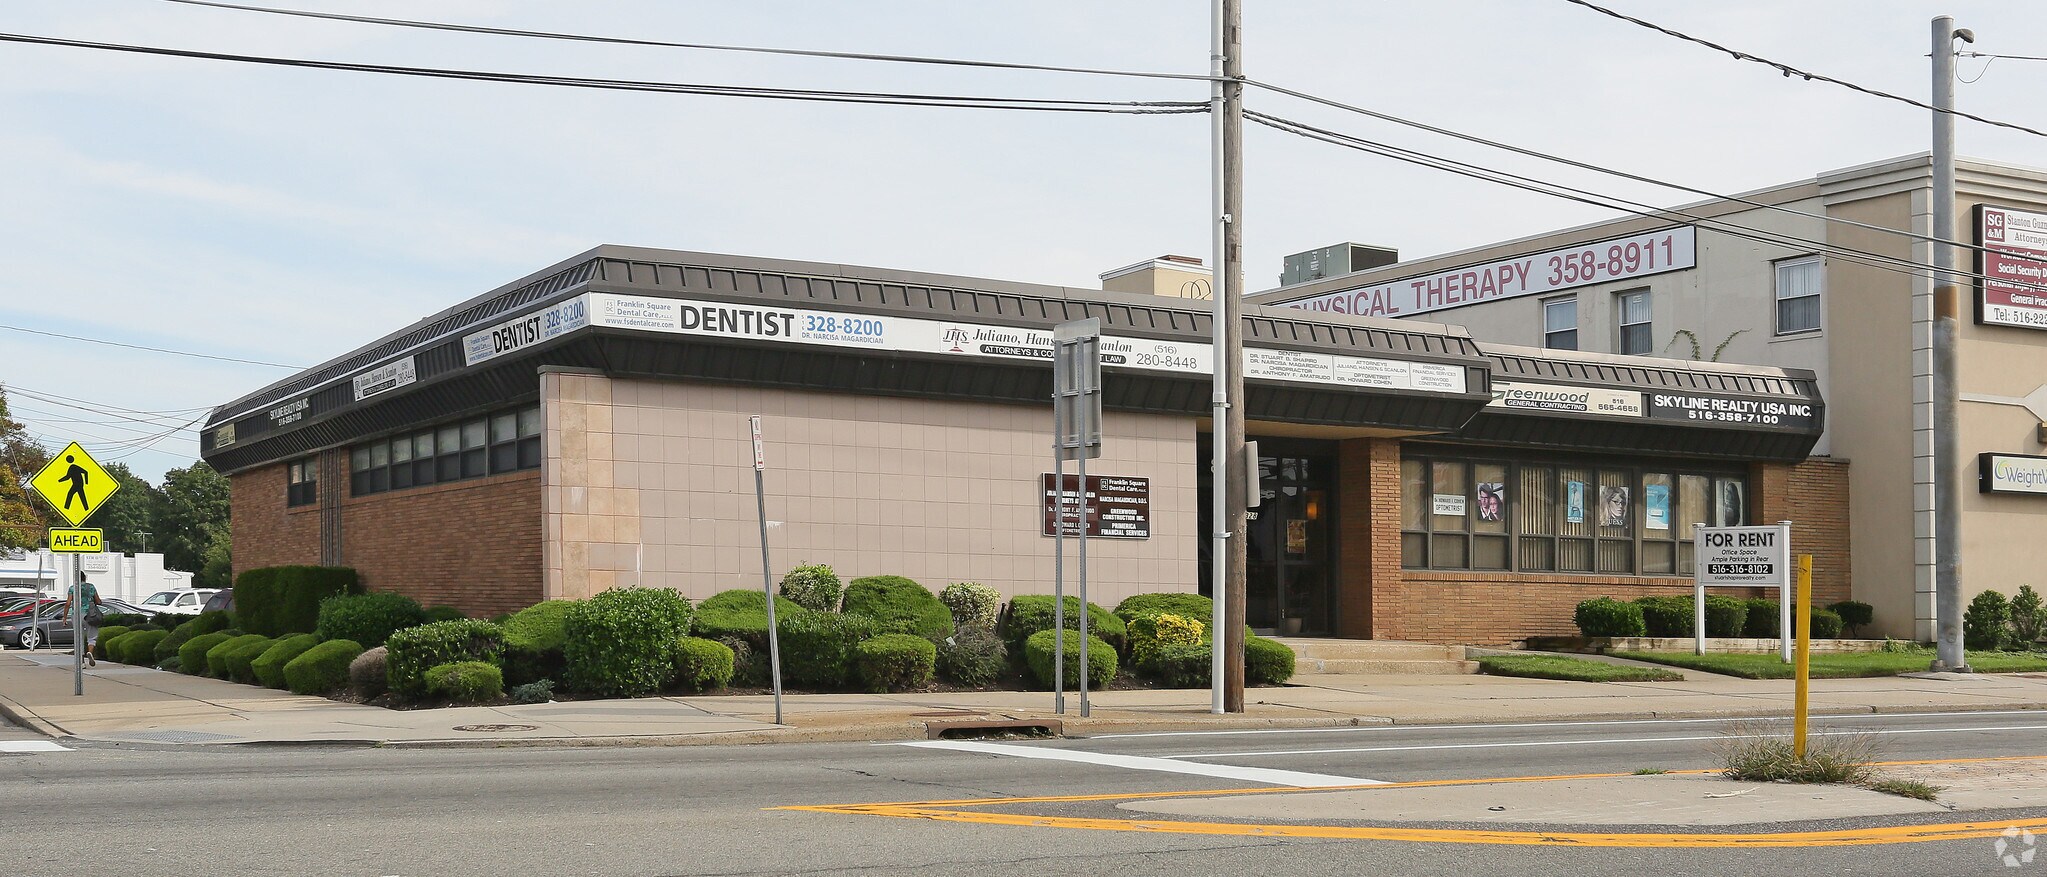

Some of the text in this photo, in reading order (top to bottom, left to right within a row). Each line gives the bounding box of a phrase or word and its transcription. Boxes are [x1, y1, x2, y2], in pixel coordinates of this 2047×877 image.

[1987, 214, 2003, 226] SG
[2008, 214, 2031, 228] Stanton
[1987, 228, 2003, 239] &M
[1290, 234, 1673, 316] YSICAL THERAPY 358-8911
[1998, 262, 2016, 274] Social
[2017, 265, 2042, 279] Security
[617, 300, 672, 310] Franklin Square
[2010, 294, 2034, 305] General
[546, 300, 584, 329] 328-8200
[617, 308, 640, 316] Dental
[1994, 308, 2010, 322] Tel:
[604, 318, 674, 328] www.fsdentalcare.com
[680, 304, 795, 337] DENTIST
[806, 315, 884, 336] 328-8200
[492, 316, 541, 354] DENTIST
[840, 336, 884, 344] MAGARDICIAN
[972, 328, 1132, 352] Juliano, Hans anlon
[984, 345, 1032, 356] ATTORNEYS
[1154, 344, 1177, 355] (516)
[1136, 353, 1197, 369] 280-8448
[1269, 366, 1313, 374] CHIROPRACTOR
[1540, 402, 1586, 411] CONTRACTING
[1654, 394, 1812, 417] SKYLINE REALTY USA INC.
[1688, 410, 1779, 424] 516-358-7100
[54, 535, 99, 547] AHEAD
[1705, 533, 1775, 547] FOR RENT
[1712, 565, 1768, 573] 516-316-8102
